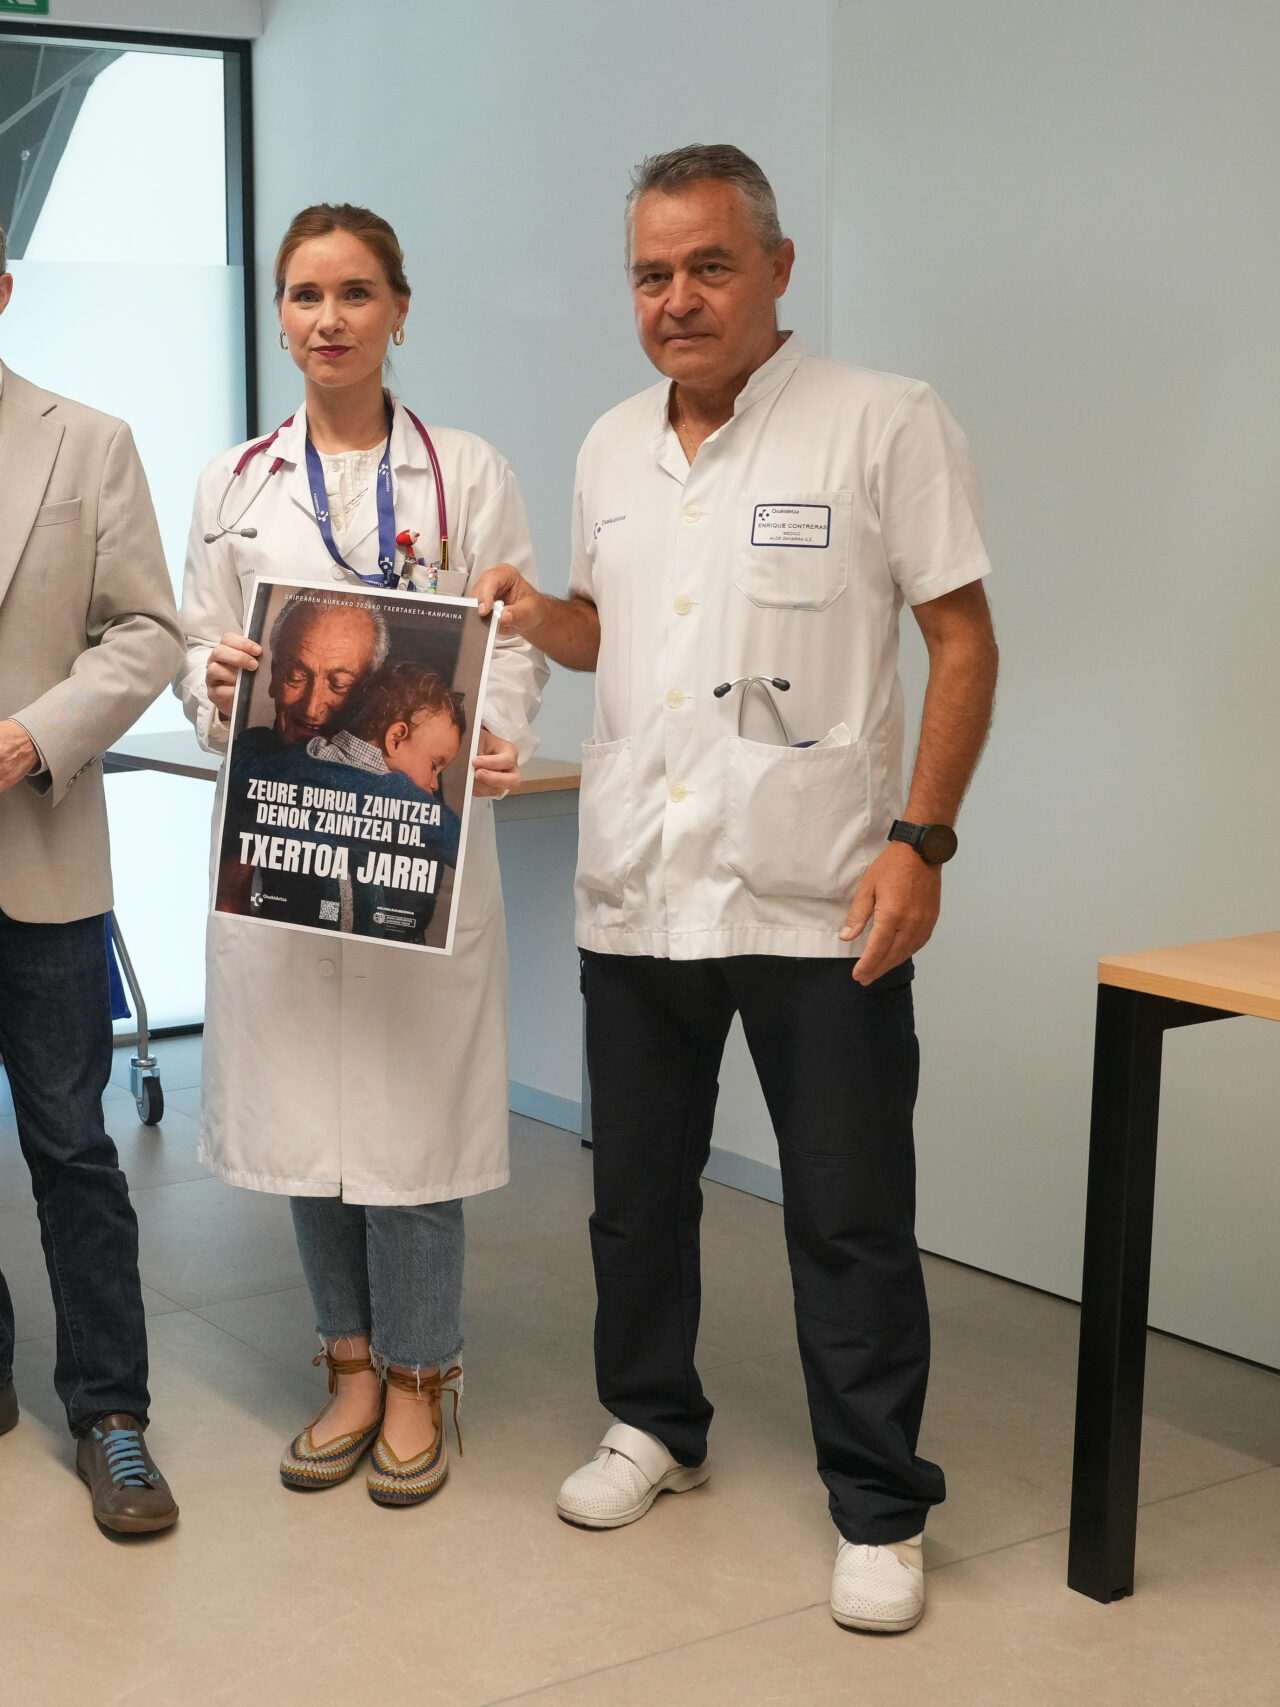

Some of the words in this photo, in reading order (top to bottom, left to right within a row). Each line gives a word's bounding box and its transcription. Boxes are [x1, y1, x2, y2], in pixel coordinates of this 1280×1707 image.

[247, 779, 298, 806] ZEURE
[303, 785, 357, 814] BURUA
[362, 793, 441, 827] ZAINTZEA
[256, 802, 310, 831] DENOK
[314, 810, 393, 842] ZAINTZEA
[397, 824, 426, 848] DA.
[239, 832, 349, 881] TXERTOA
[356, 851, 438, 894] JARRI
